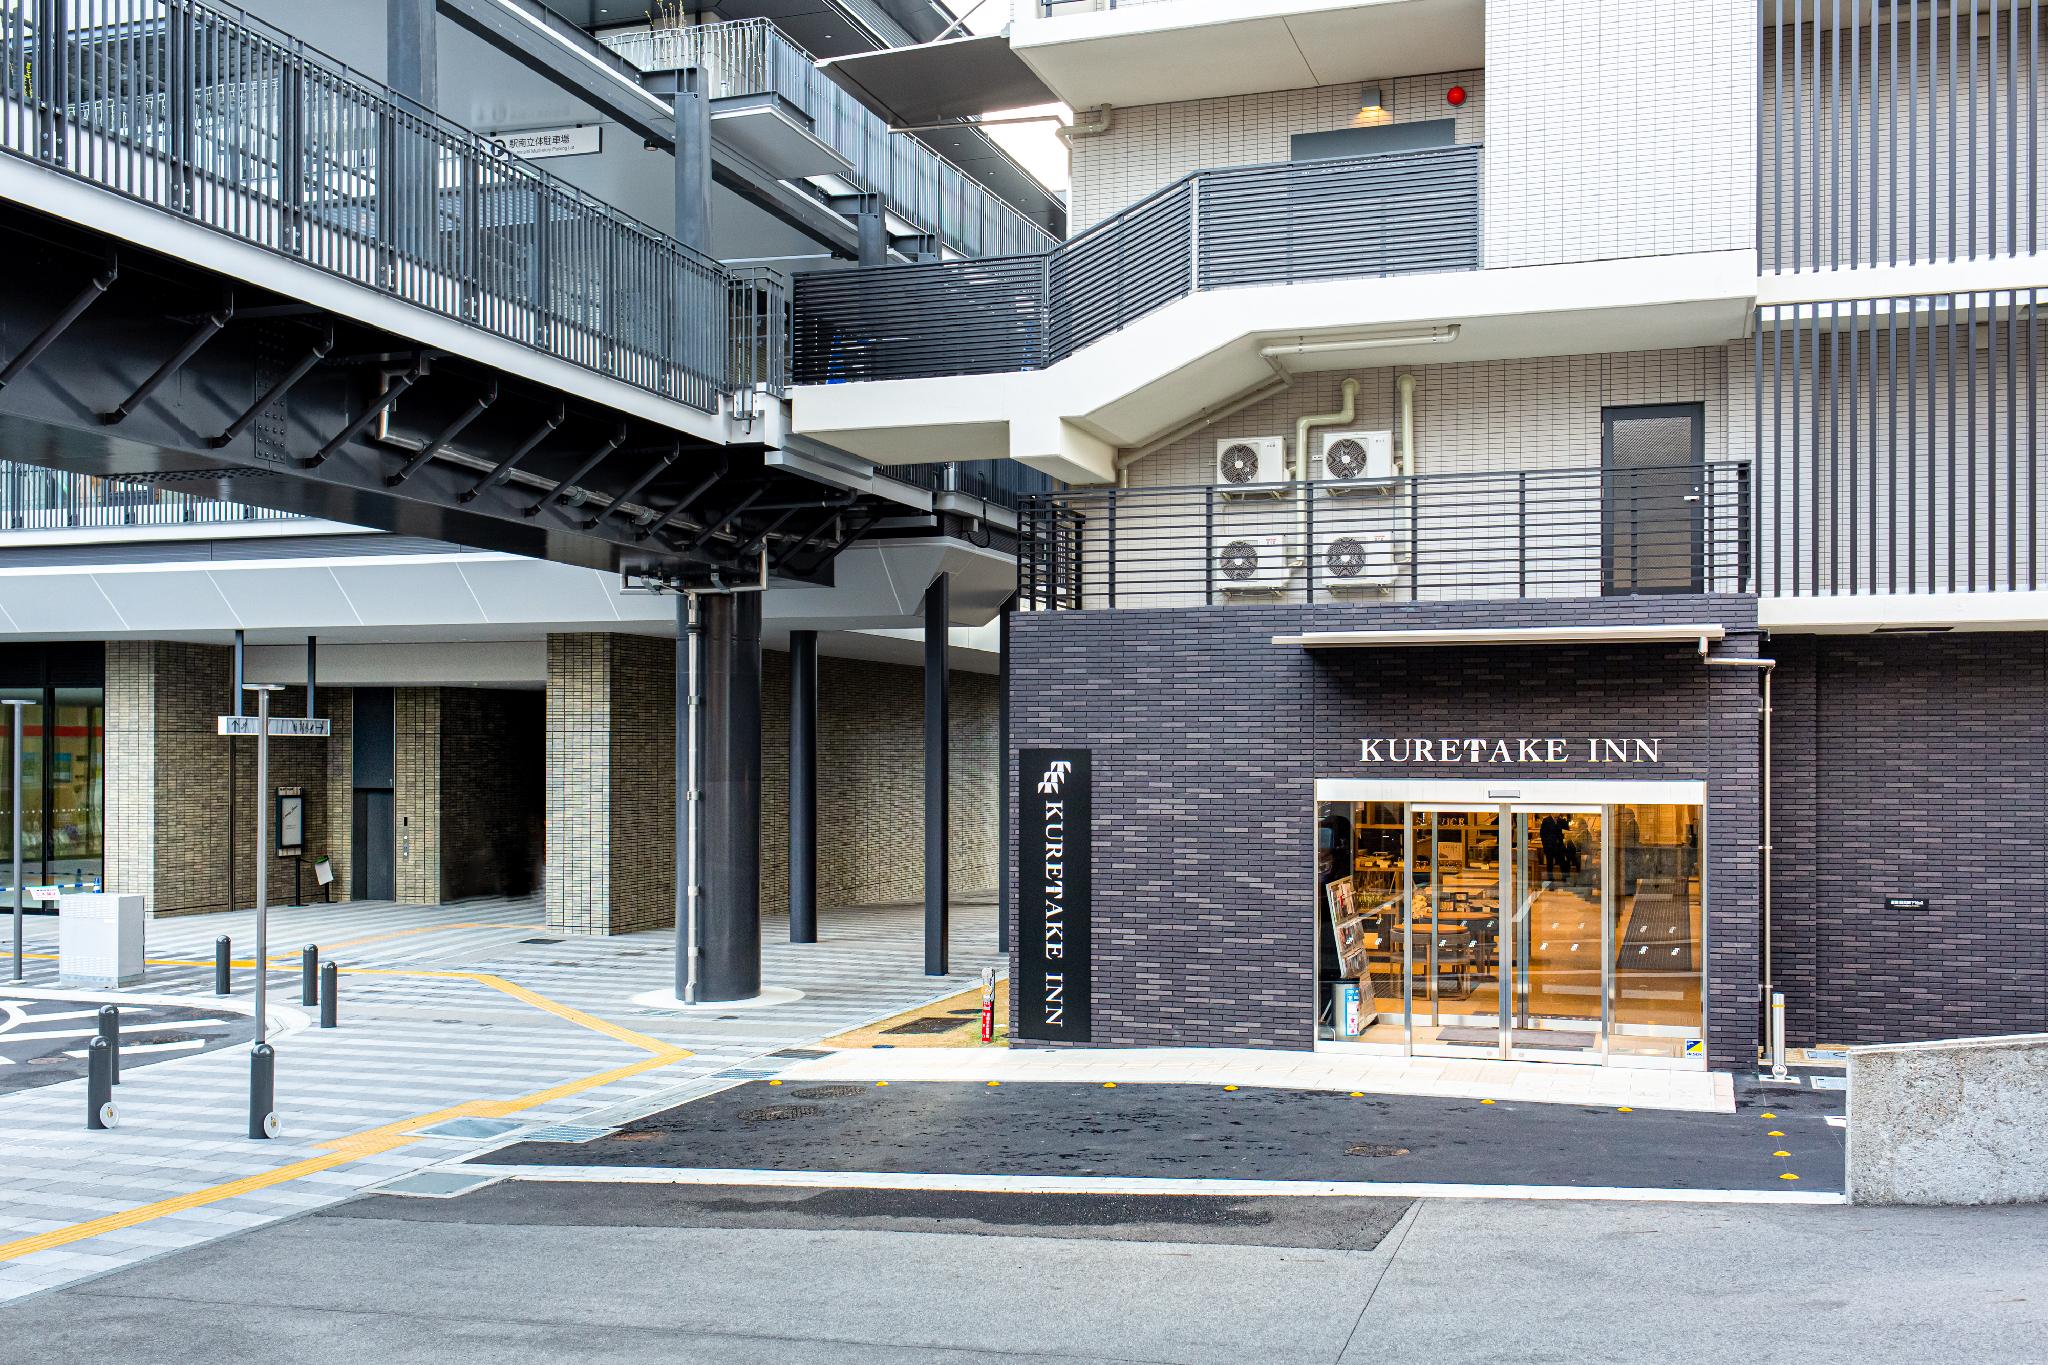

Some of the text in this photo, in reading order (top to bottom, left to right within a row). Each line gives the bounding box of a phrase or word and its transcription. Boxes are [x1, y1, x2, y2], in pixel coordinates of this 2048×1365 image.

[509, 135, 570, 148] 駅南立体駐車場
[1359, 738, 1661, 763] KURETAKE INN
[1045, 800, 1063, 1027] KURETAKE INN
